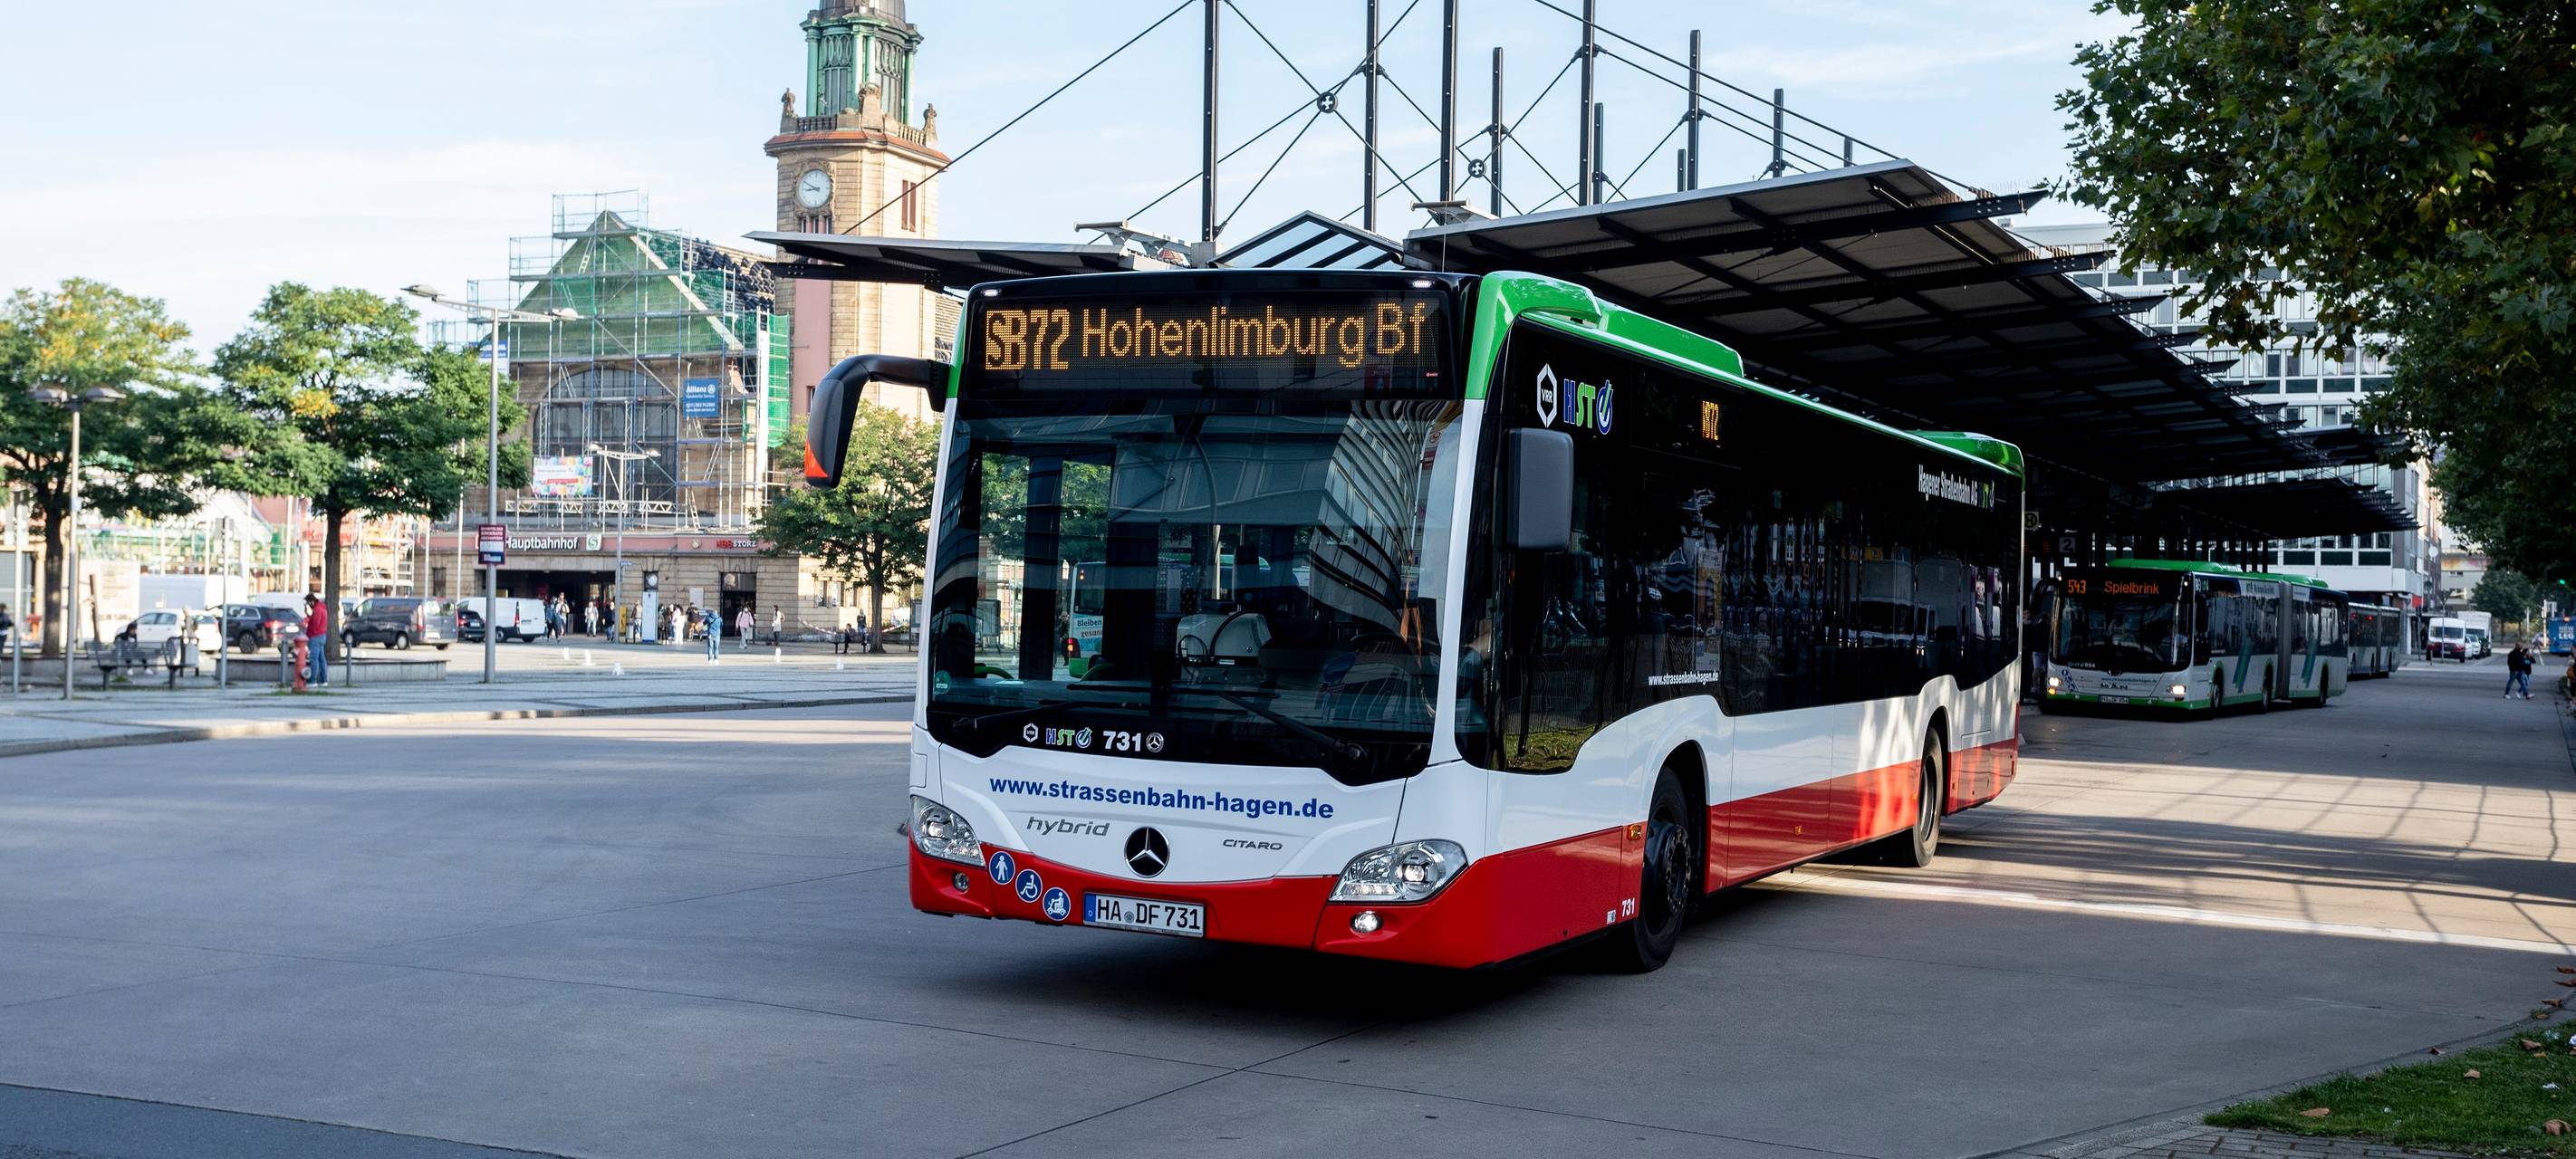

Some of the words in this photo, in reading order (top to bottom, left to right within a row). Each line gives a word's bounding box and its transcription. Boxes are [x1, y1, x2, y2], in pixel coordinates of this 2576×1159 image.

[985, 309, 1070, 369] SB72
[1082, 305, 1364, 368] Hohenlimburg
[1377, 302, 1424, 355] Bf
[686, 385, 707, 393] Allianz
[1541, 388, 1553, 405] VRR
[1563, 378, 1596, 428] HST
[1918, 464, 1940, 502] Hagener
[1940, 470, 1971, 505] Straßenbahn
[1970, 480, 1978, 507] AG
[506, 536, 578, 551] Hauptbahnhof
[2062, 539, 2074, 551] 2
[2068, 580, 2087, 594] 543
[2103, 580, 2159, 595] Spielbrink
[1077, 618, 1102, 627] Bleiben
[1648, 669, 1719, 686] www.strassenbahn-hagen.de
[1045, 727, 1075, 746] HST
[1102, 730, 1141, 752] 731
[989, 777, 1334, 819] www.strassenbahn-hagen.de
[1026, 816, 1110, 837] hybrid
[1222, 838, 1283, 851] CITARO
[1097, 898, 1122, 922] HA
[1136, 902, 1161, 924] DF
[1164, 905, 1200, 930] 731
[1621, 897, 1635, 917] 731
